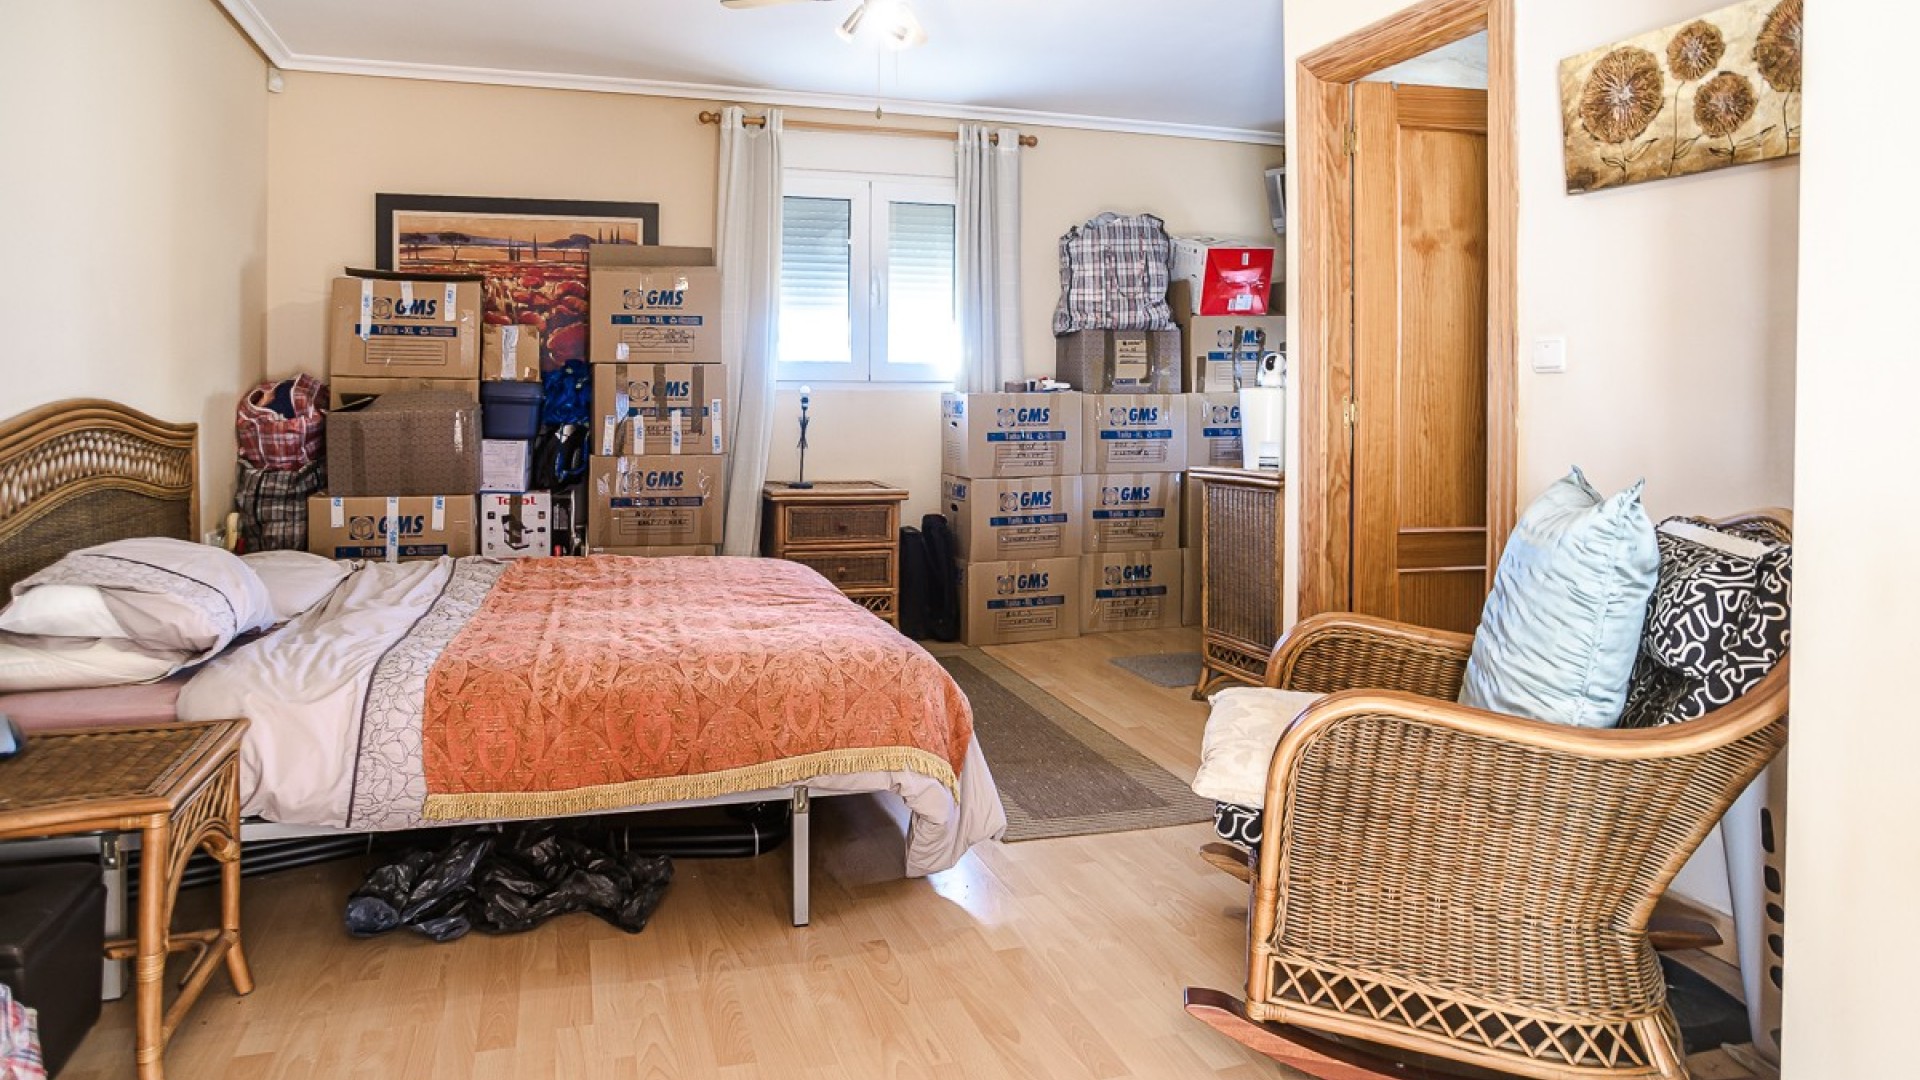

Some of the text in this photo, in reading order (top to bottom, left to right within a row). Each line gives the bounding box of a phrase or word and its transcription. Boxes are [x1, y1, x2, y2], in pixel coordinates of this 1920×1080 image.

[646, 289, 684, 306] GMS
[394, 298, 438, 316] GMS
[378, 326, 399, 335] Talla
[652, 381, 690, 397] MS
[1018, 407, 1051, 423] GMS
[1128, 406, 1158, 421] GMS
[646, 470, 684, 488] GMS
[1020, 490, 1052, 507] GMS
[1121, 486, 1151, 501] GMS
[378, 515, 425, 534] GMS
[360, 547, 383, 557] Talla
[1123, 564, 1153, 579] GMS
[1017, 572, 1049, 589] GMS
